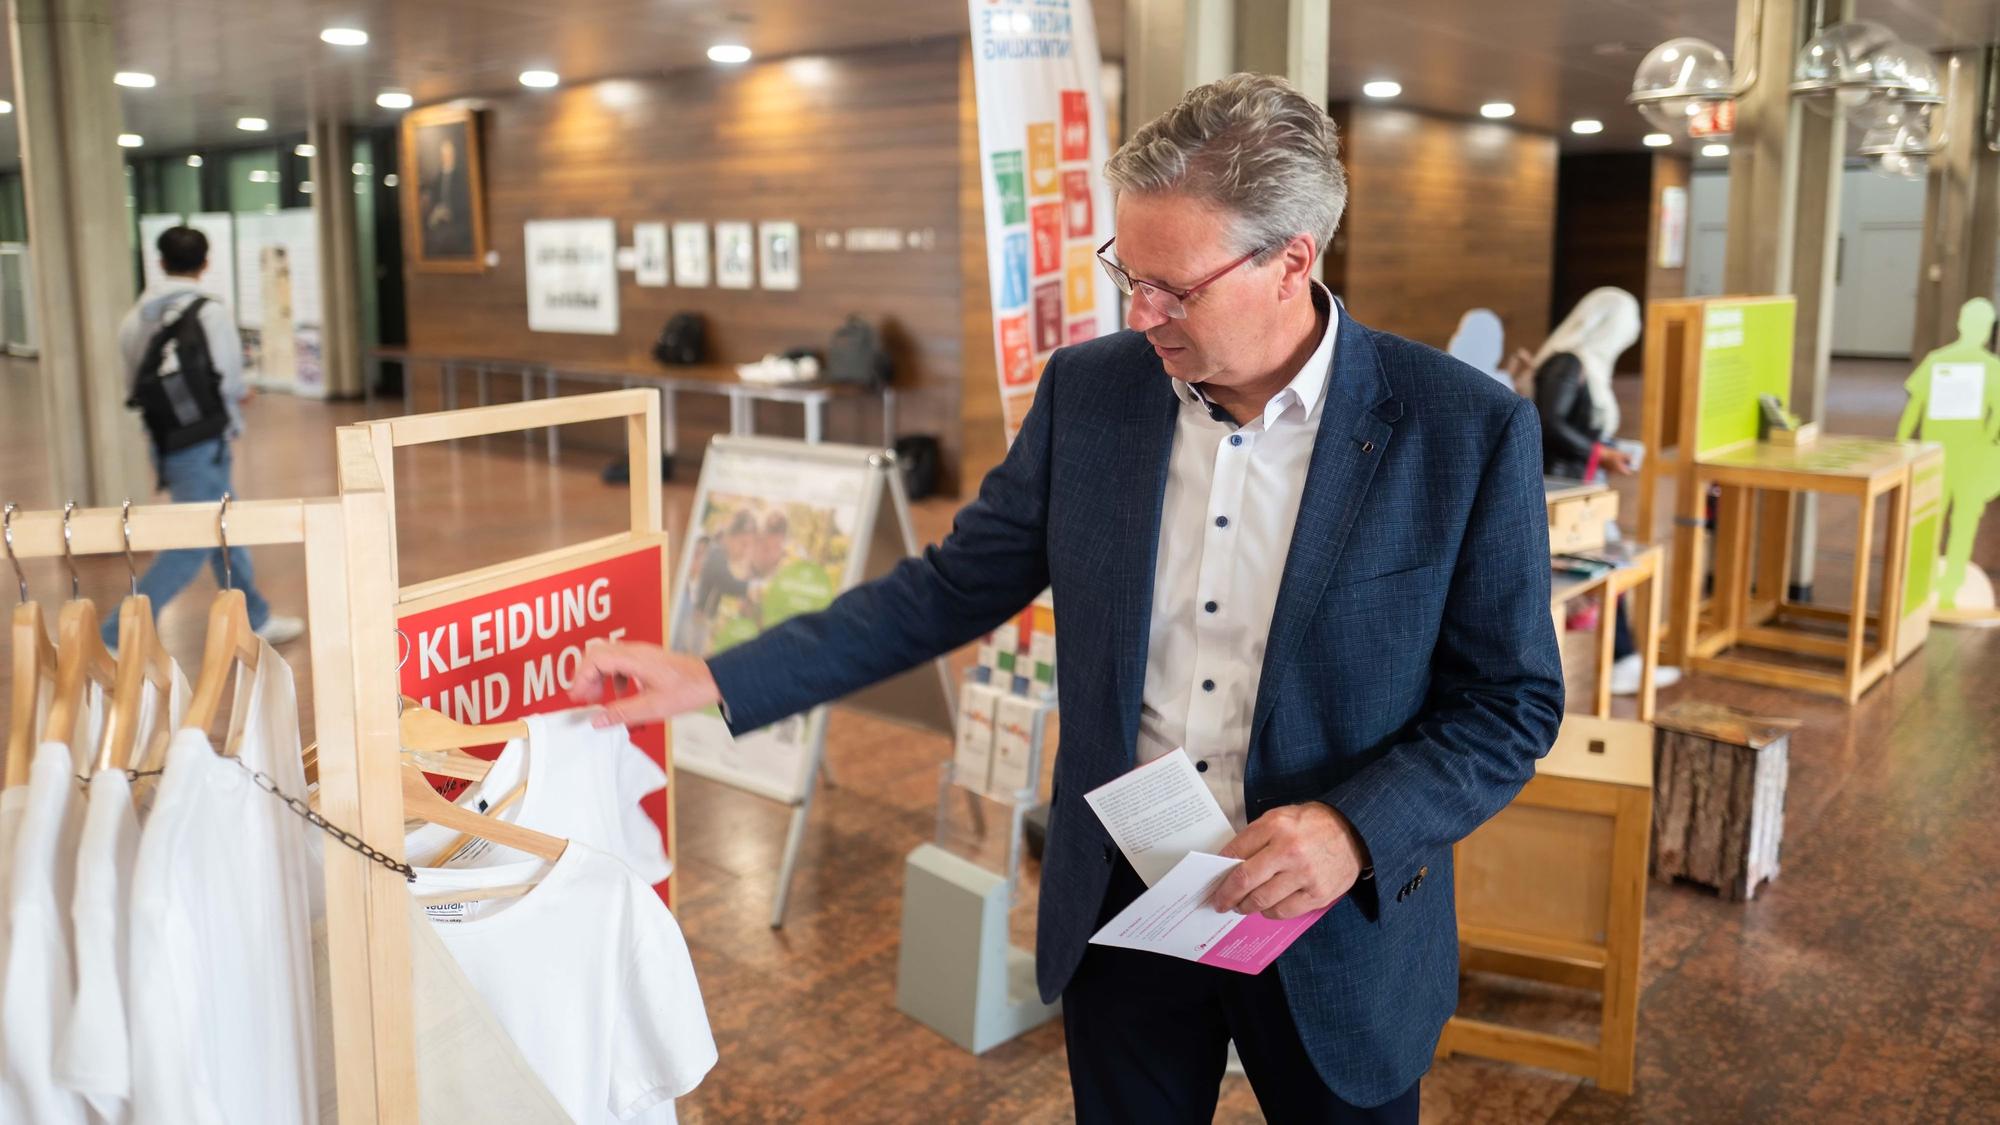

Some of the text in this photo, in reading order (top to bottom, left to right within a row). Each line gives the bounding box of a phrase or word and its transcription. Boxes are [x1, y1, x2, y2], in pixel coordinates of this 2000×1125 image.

[418, 577, 611, 680] KLEIDUNG
[522, 627, 626, 706] MO
[426, 902, 462, 911] eutral
